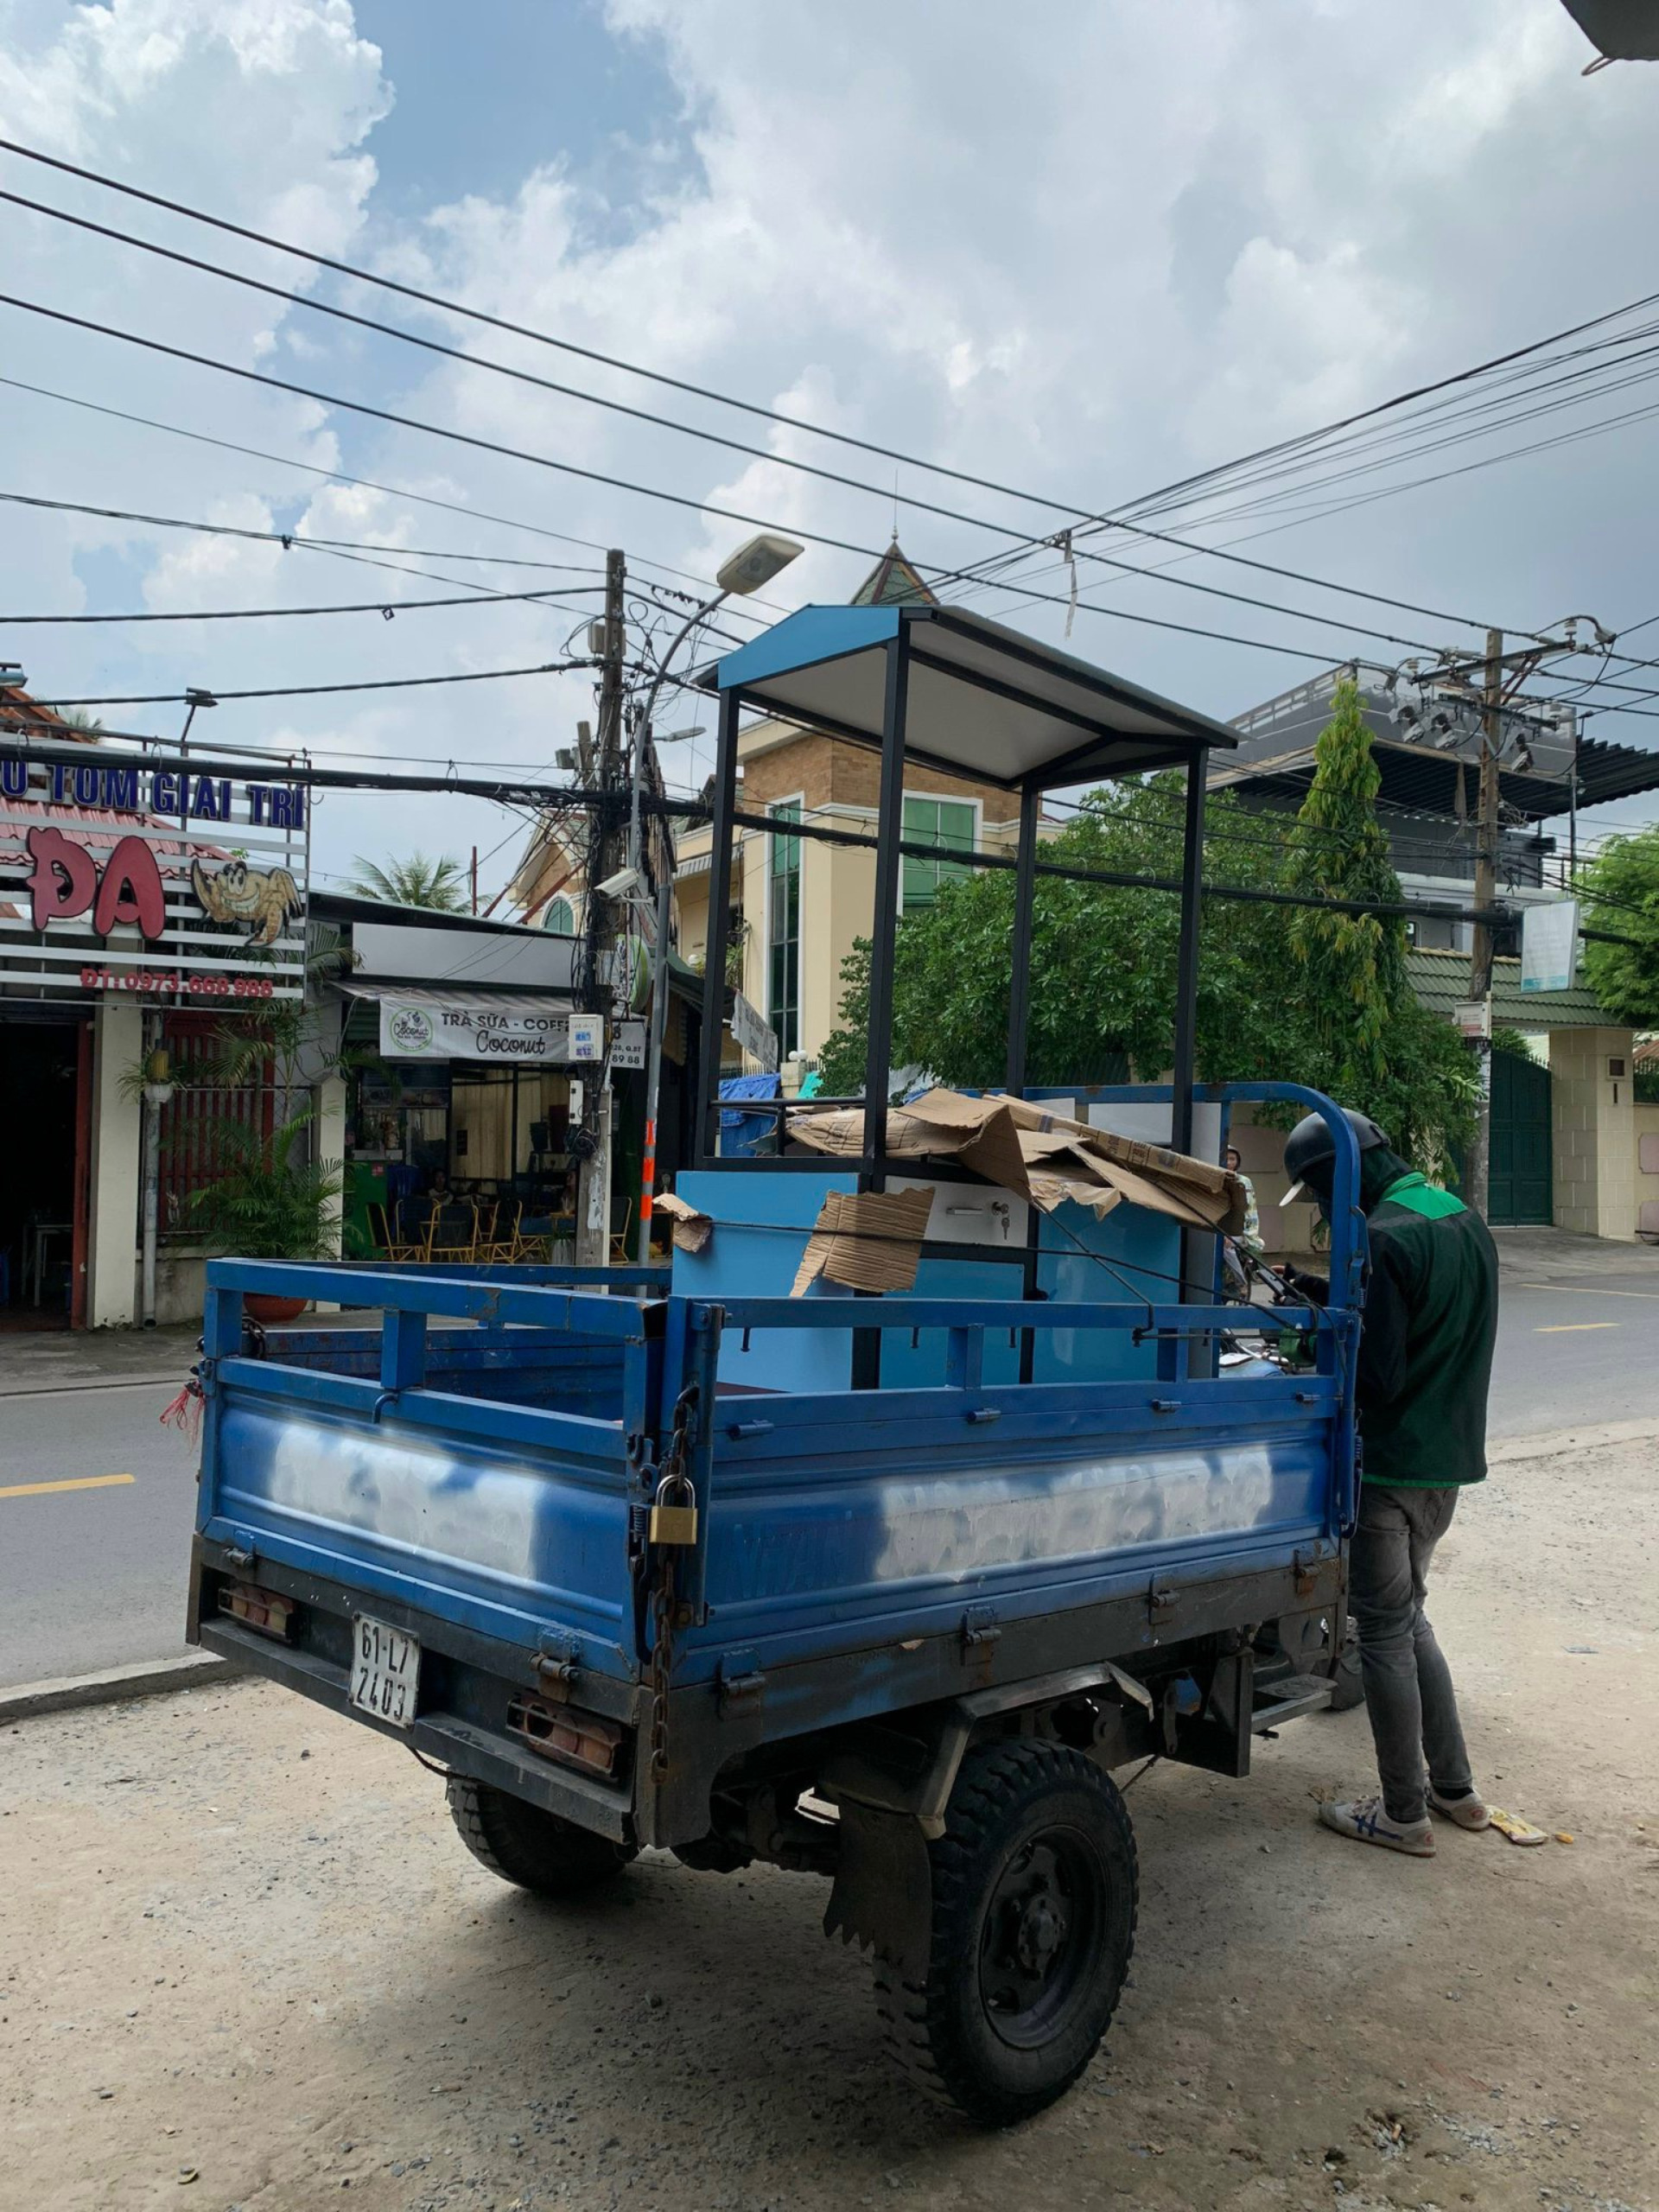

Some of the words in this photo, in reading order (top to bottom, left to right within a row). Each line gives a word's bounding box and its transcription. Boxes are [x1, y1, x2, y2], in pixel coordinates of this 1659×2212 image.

[248, 783, 305, 830] TRÍ
[80, 968, 119, 989] ĐT:
[442, 1011, 472, 1027] TRÀ
[478, 1014, 509, 1028] SỮA
[476, 1029, 546, 1054] Coconut
[356, 1667, 406, 1721] 2403
